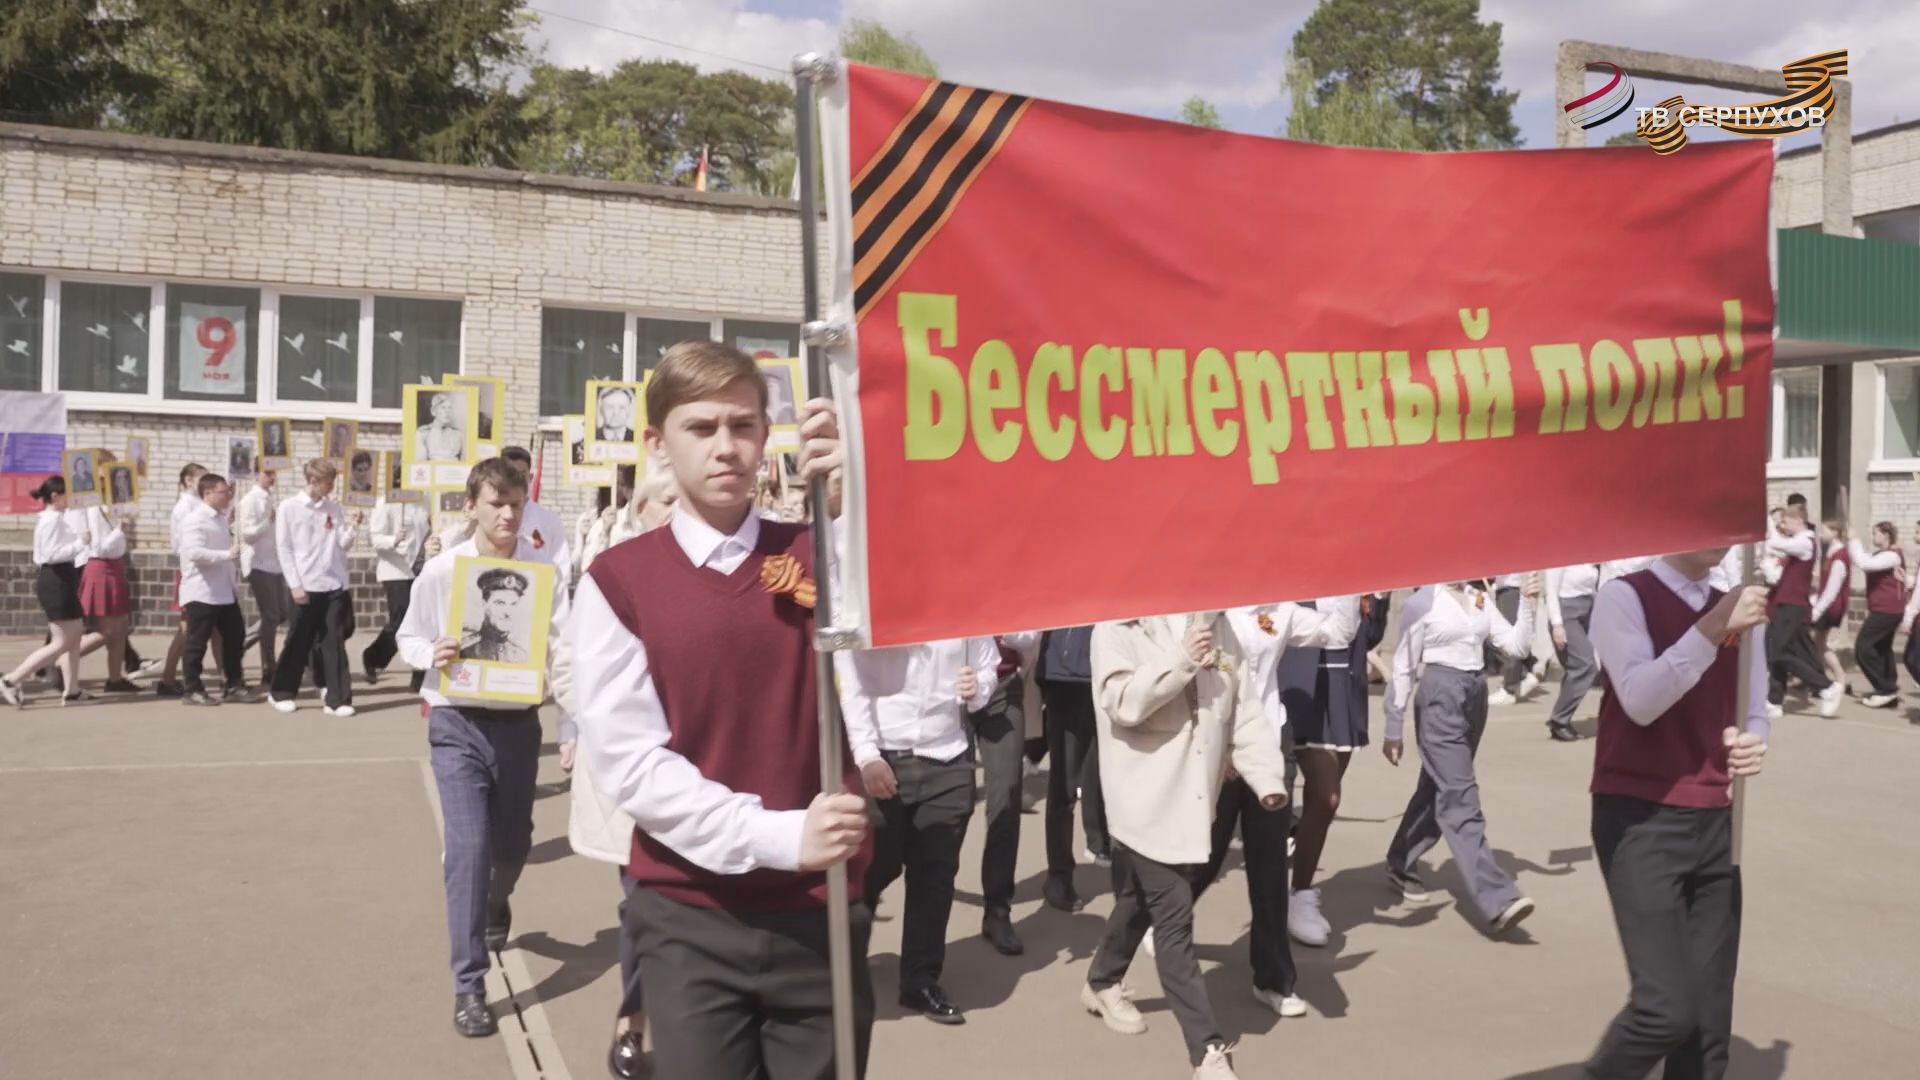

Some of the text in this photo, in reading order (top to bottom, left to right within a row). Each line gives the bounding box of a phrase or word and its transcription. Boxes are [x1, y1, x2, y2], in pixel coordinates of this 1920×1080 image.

[196, 316, 236, 367] 9
[897, 291, 1745, 485] Бессмертный полк!
